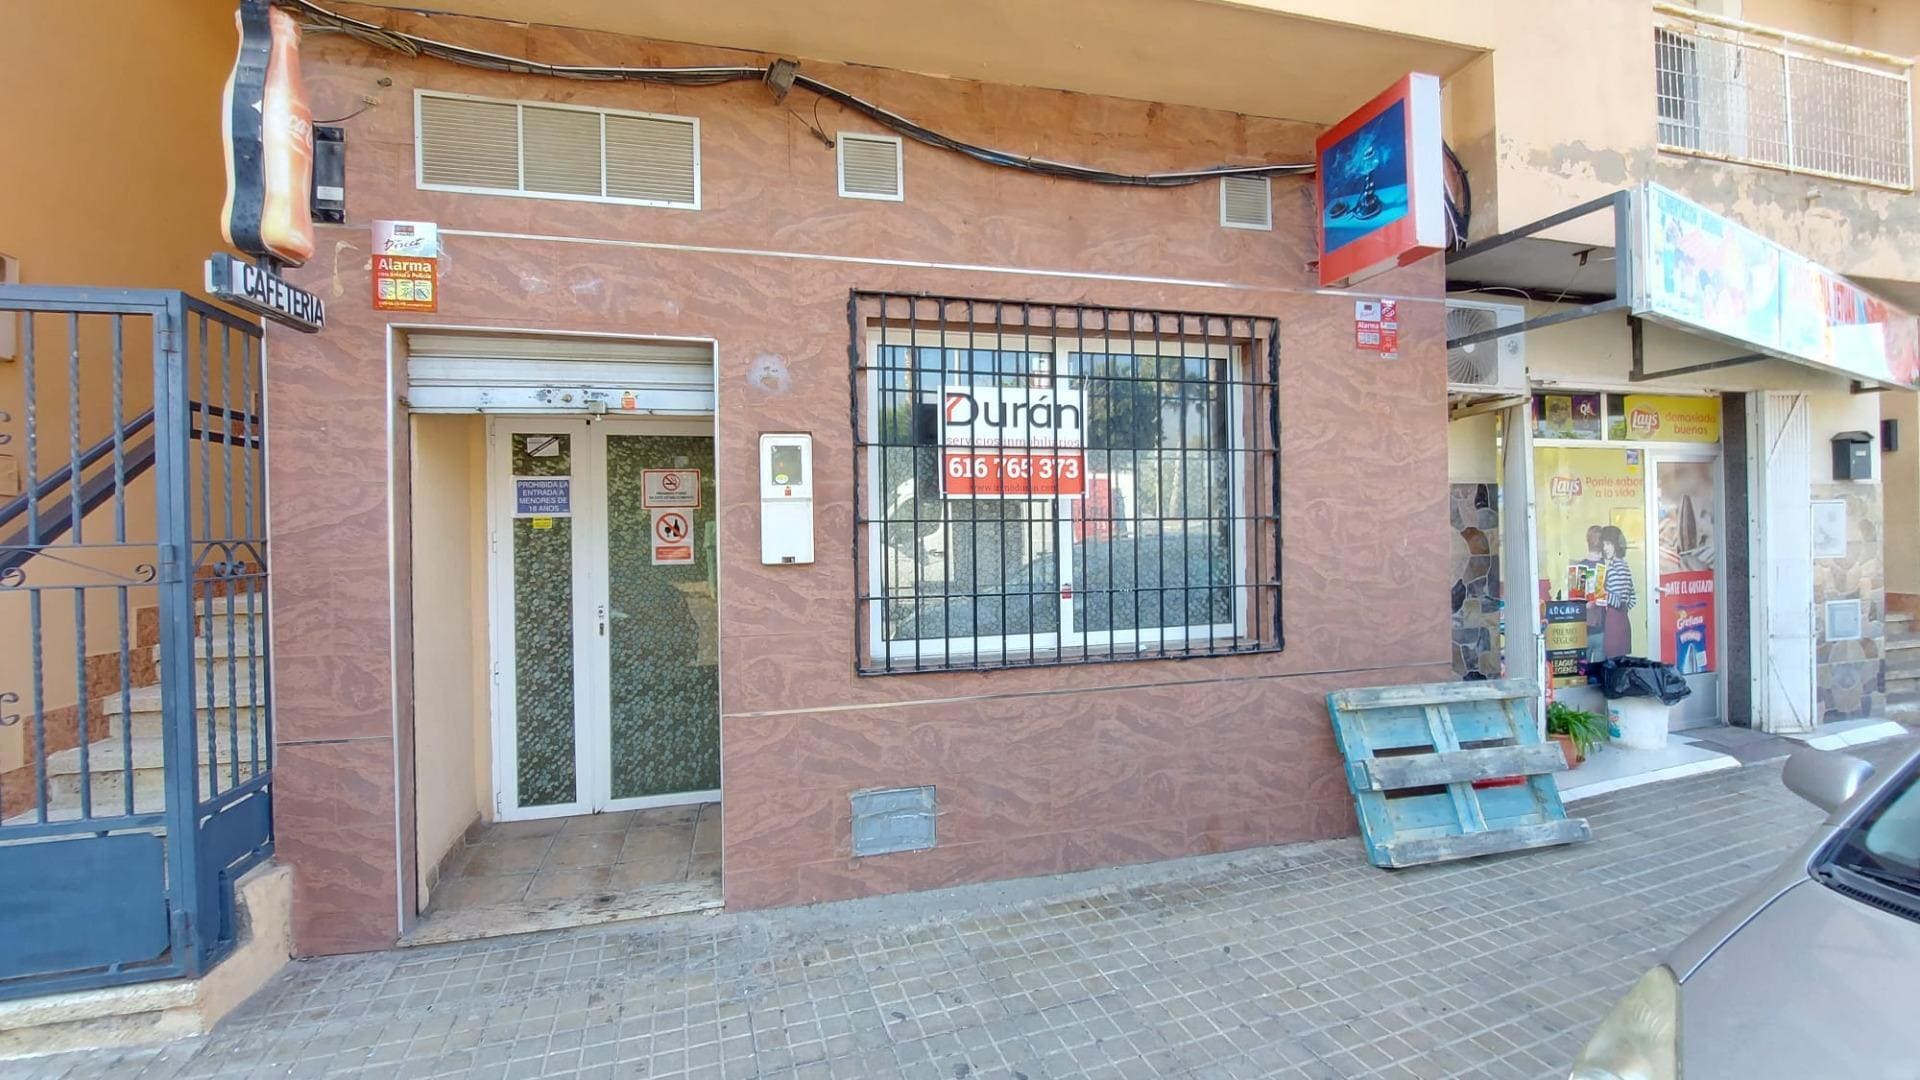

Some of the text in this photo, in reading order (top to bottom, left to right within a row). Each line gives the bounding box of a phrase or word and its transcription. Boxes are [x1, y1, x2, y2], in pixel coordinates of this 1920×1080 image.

[378, 258, 432, 272] Alarma
[243, 263, 324, 327] CAFETERIA
[946, 392, 1080, 429] Durán
[1673, 424, 1708, 434] buenas
[947, 436, 1000, 446] servcios
[949, 457, 1079, 479] 616 765 373
[518, 481, 557, 489] PROHIBIDA
[1616, 476, 1642, 487] sabor
[1595, 487, 1635, 498] a la vida
[528, 505, 560, 513] 18 AÑOS
[1681, 581, 1688, 594] EL
[1677, 615, 1704, 630] Grefusa
